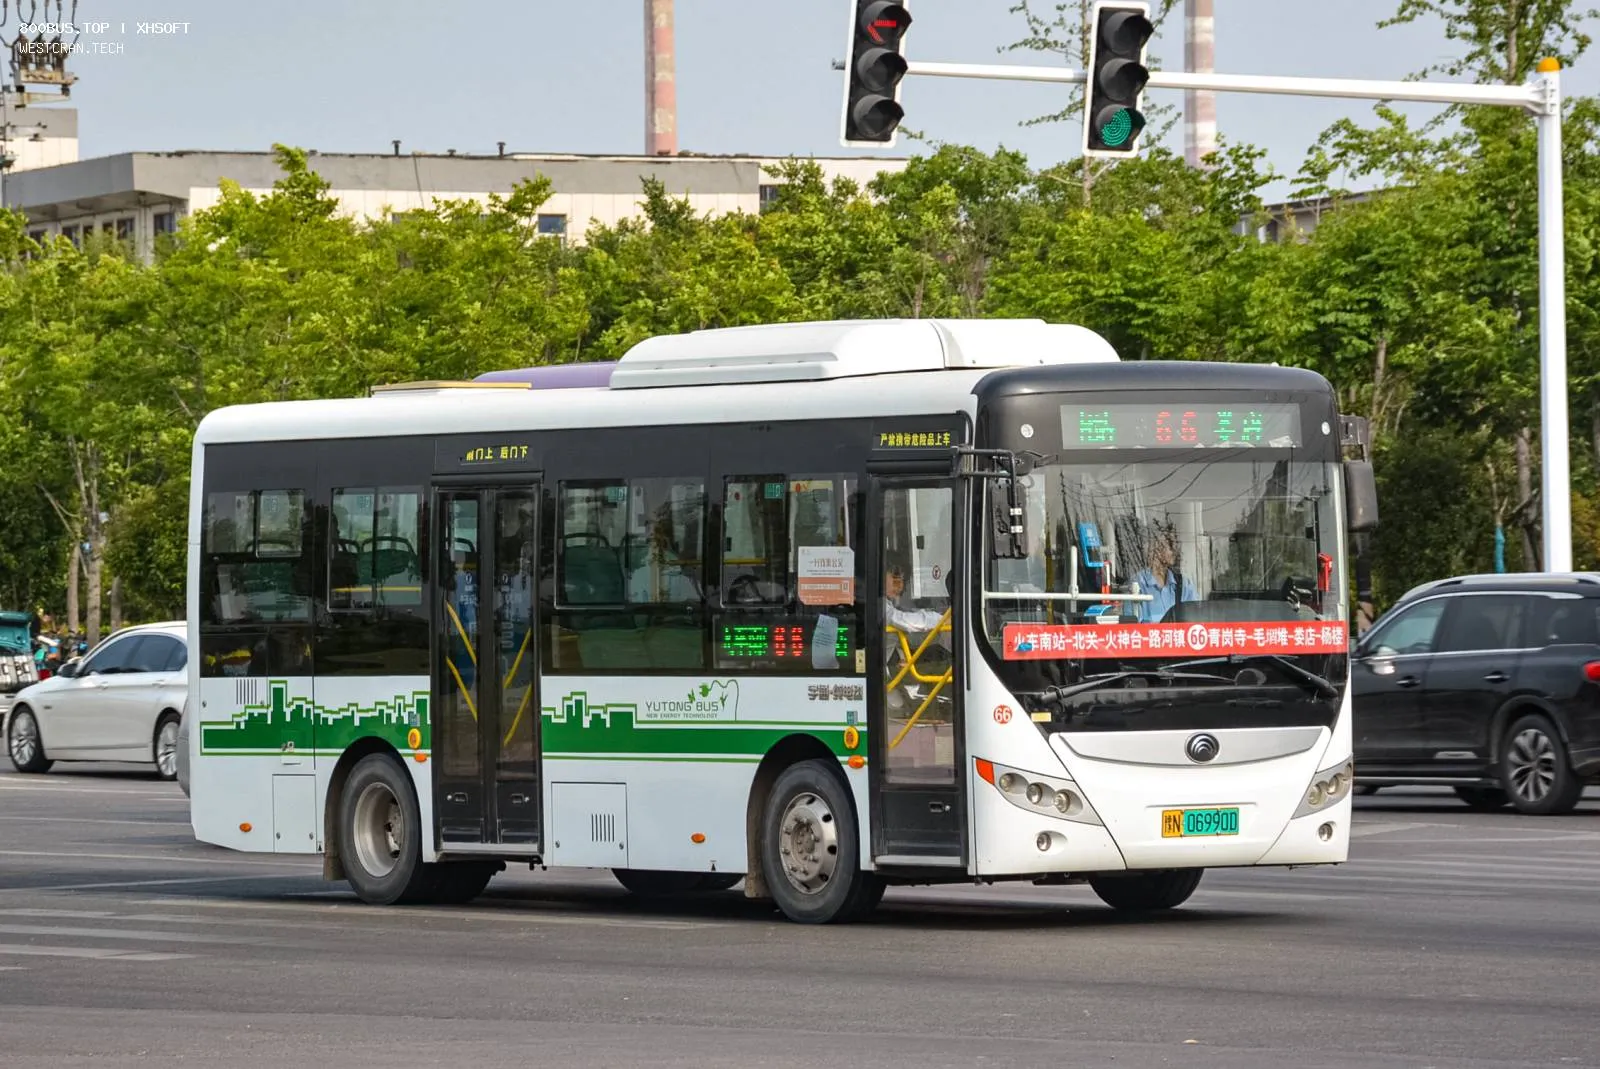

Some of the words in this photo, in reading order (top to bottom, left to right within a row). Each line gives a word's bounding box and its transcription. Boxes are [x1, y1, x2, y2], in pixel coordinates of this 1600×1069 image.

[1155, 411, 1197, 441] 66
[1191, 629, 1206, 646] 66
[645, 701, 692, 712] YUTONG
[696, 701, 719, 712] BUS
[995, 707, 1011, 722] 66
